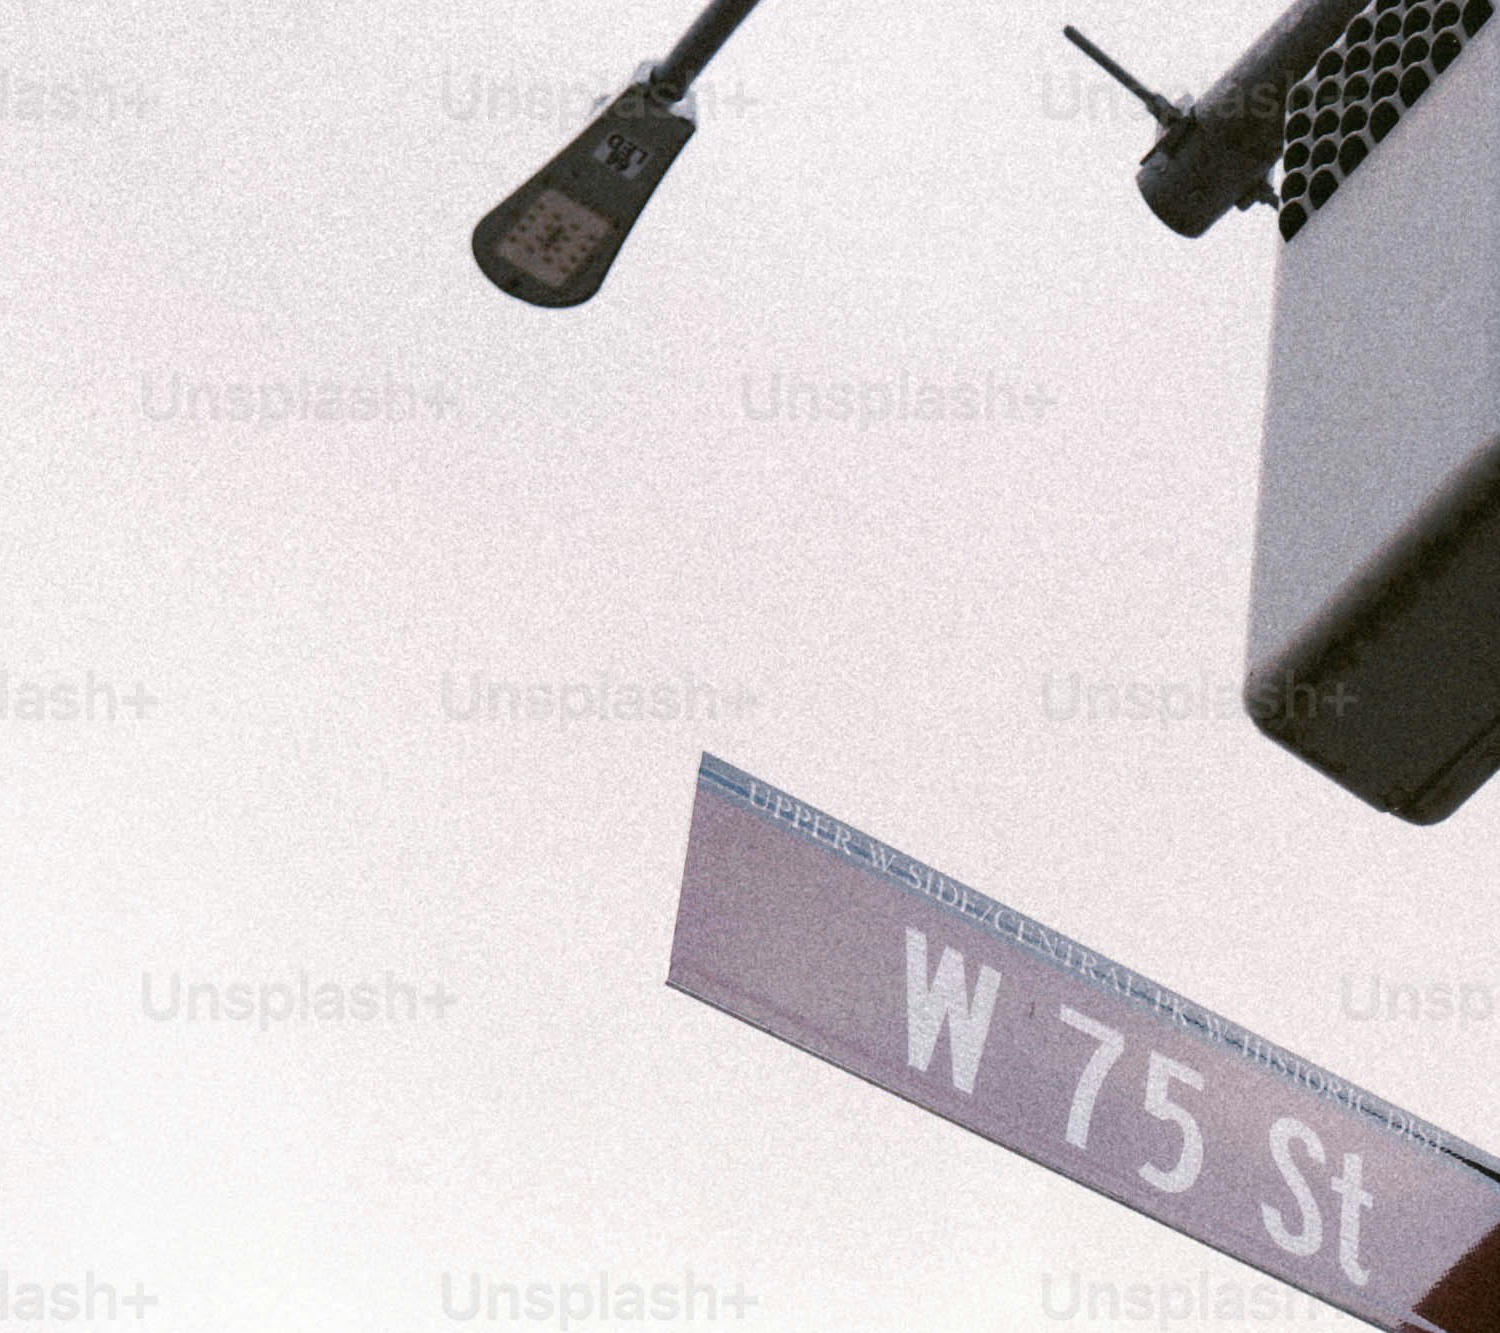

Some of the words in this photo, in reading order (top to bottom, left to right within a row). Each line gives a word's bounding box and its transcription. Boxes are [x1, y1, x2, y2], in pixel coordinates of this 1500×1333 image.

[747, 781, 853, 857] UPPER
[868, 842, 897, 877] W
[906, 862, 1144, 1001] SIDE/CENTRAL
[1154, 988, 1192, 1027] PK
[1203, 1016, 1232, 1044] W
[1240, 1037, 1369, 1118] HISTORIC
[904, 925, 1002, 1095] W
[1059, 1003, 1205, 1194] 75
[1260, 1116, 1374, 1287] St
